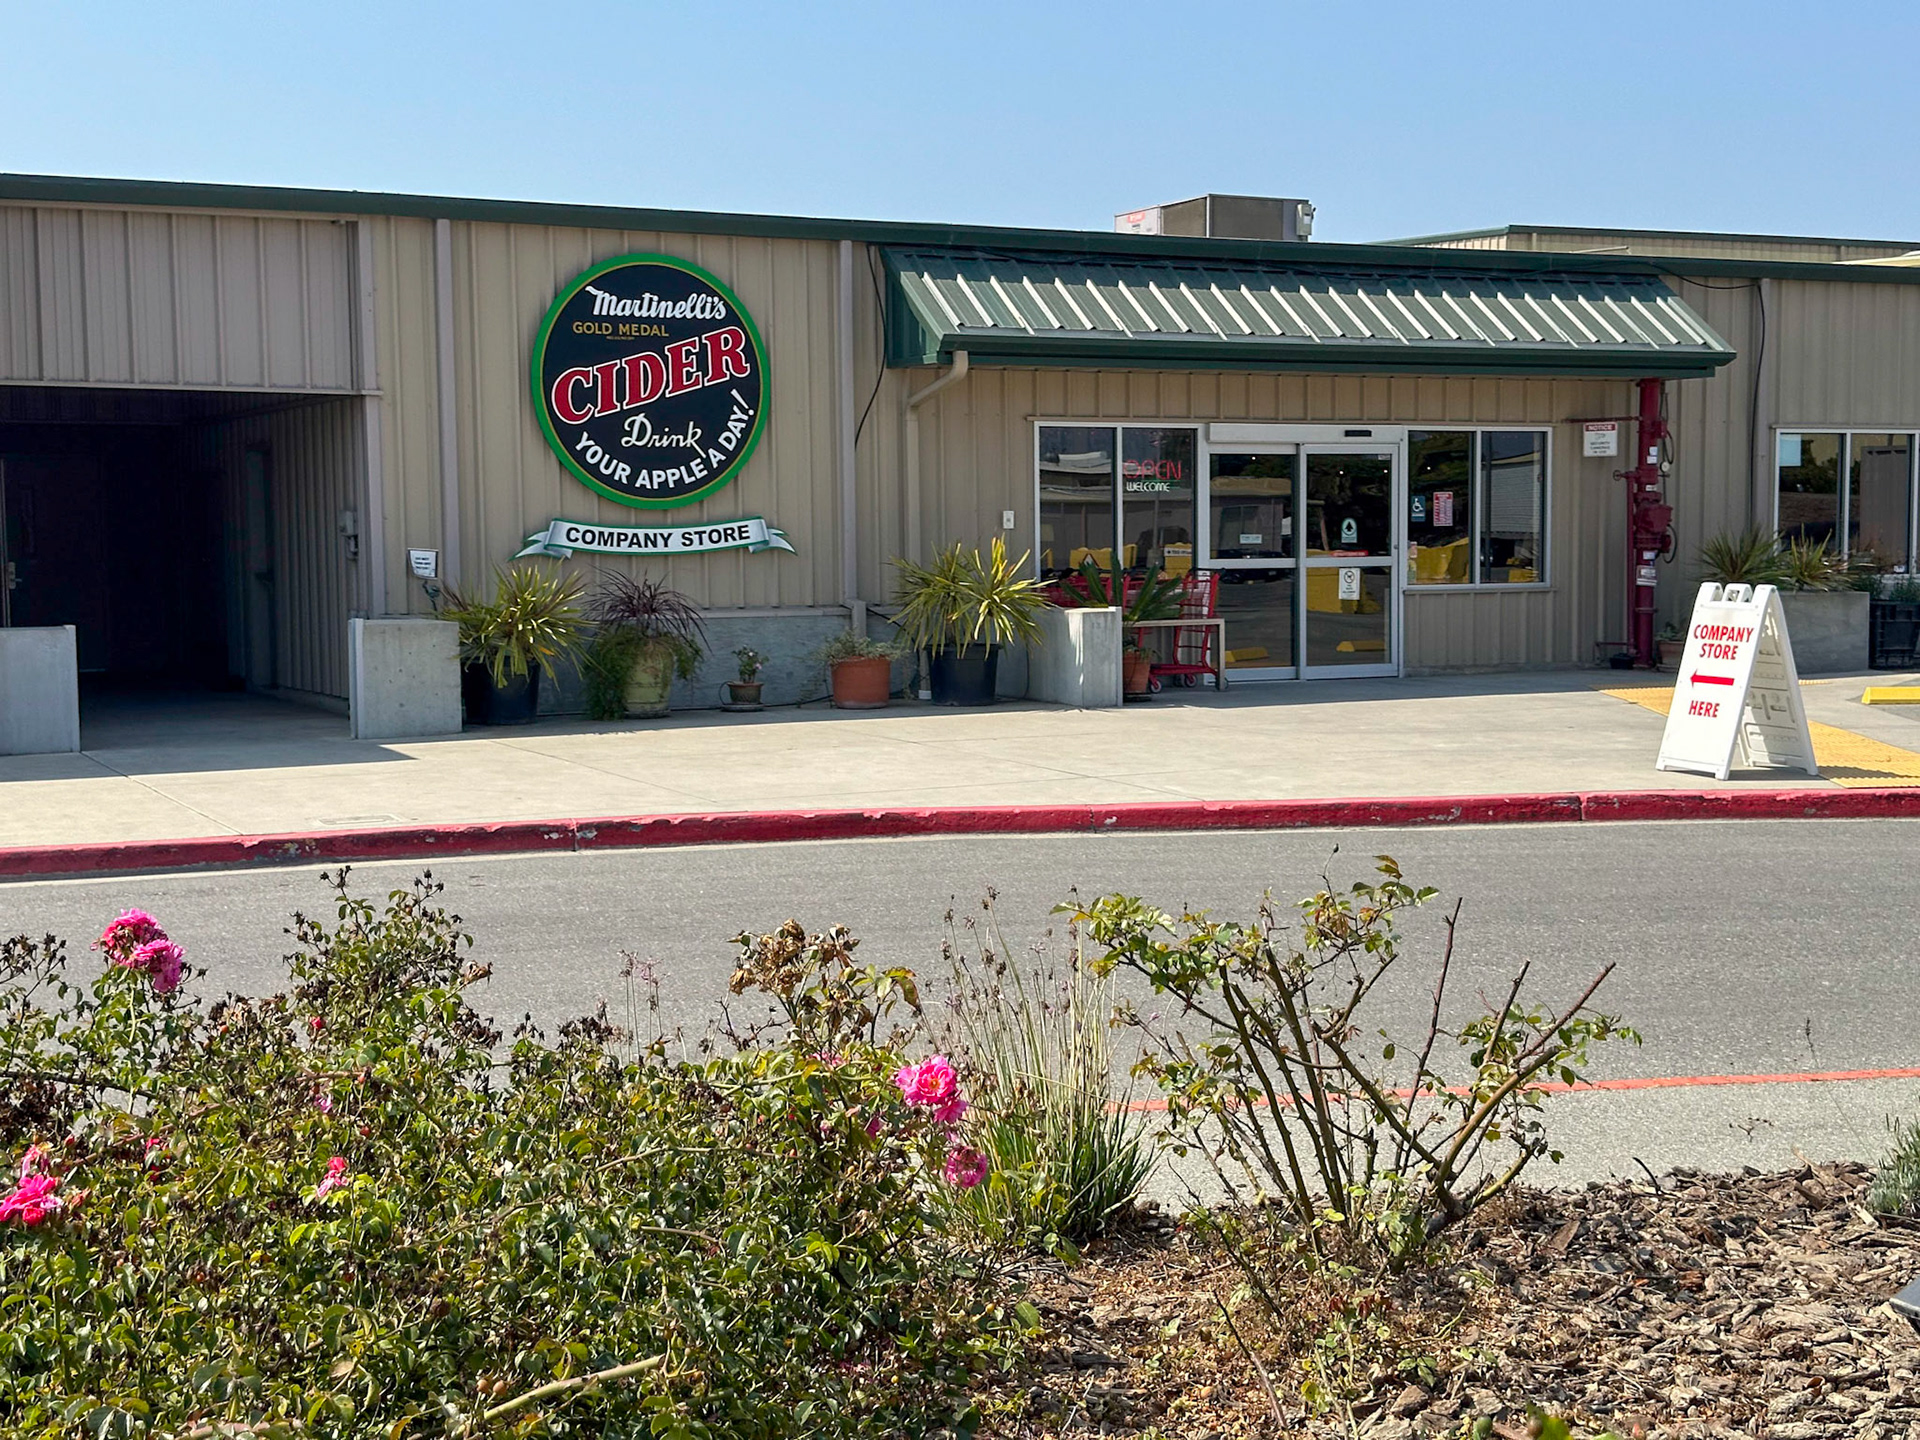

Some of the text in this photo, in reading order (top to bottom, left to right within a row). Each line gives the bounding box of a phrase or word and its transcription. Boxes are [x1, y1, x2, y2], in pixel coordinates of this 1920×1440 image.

[585, 285, 727, 320] Martinelli's
[572, 321, 670, 337] GOLD MEDAL
[551, 326, 751, 425] CIDER
[575, 388, 756, 490] YOUR APPLE A DAY!
[620, 412, 707, 459] Drink
[1123, 459, 1182, 480] OPEN
[1126, 481, 1171, 492] WELCOME
[565, 524, 751, 549] COMPANY STORE
[1693, 624, 1755, 643] COMPANY
[1699, 643, 1739, 660] STORE
[1688, 700, 1720, 718] HERE
